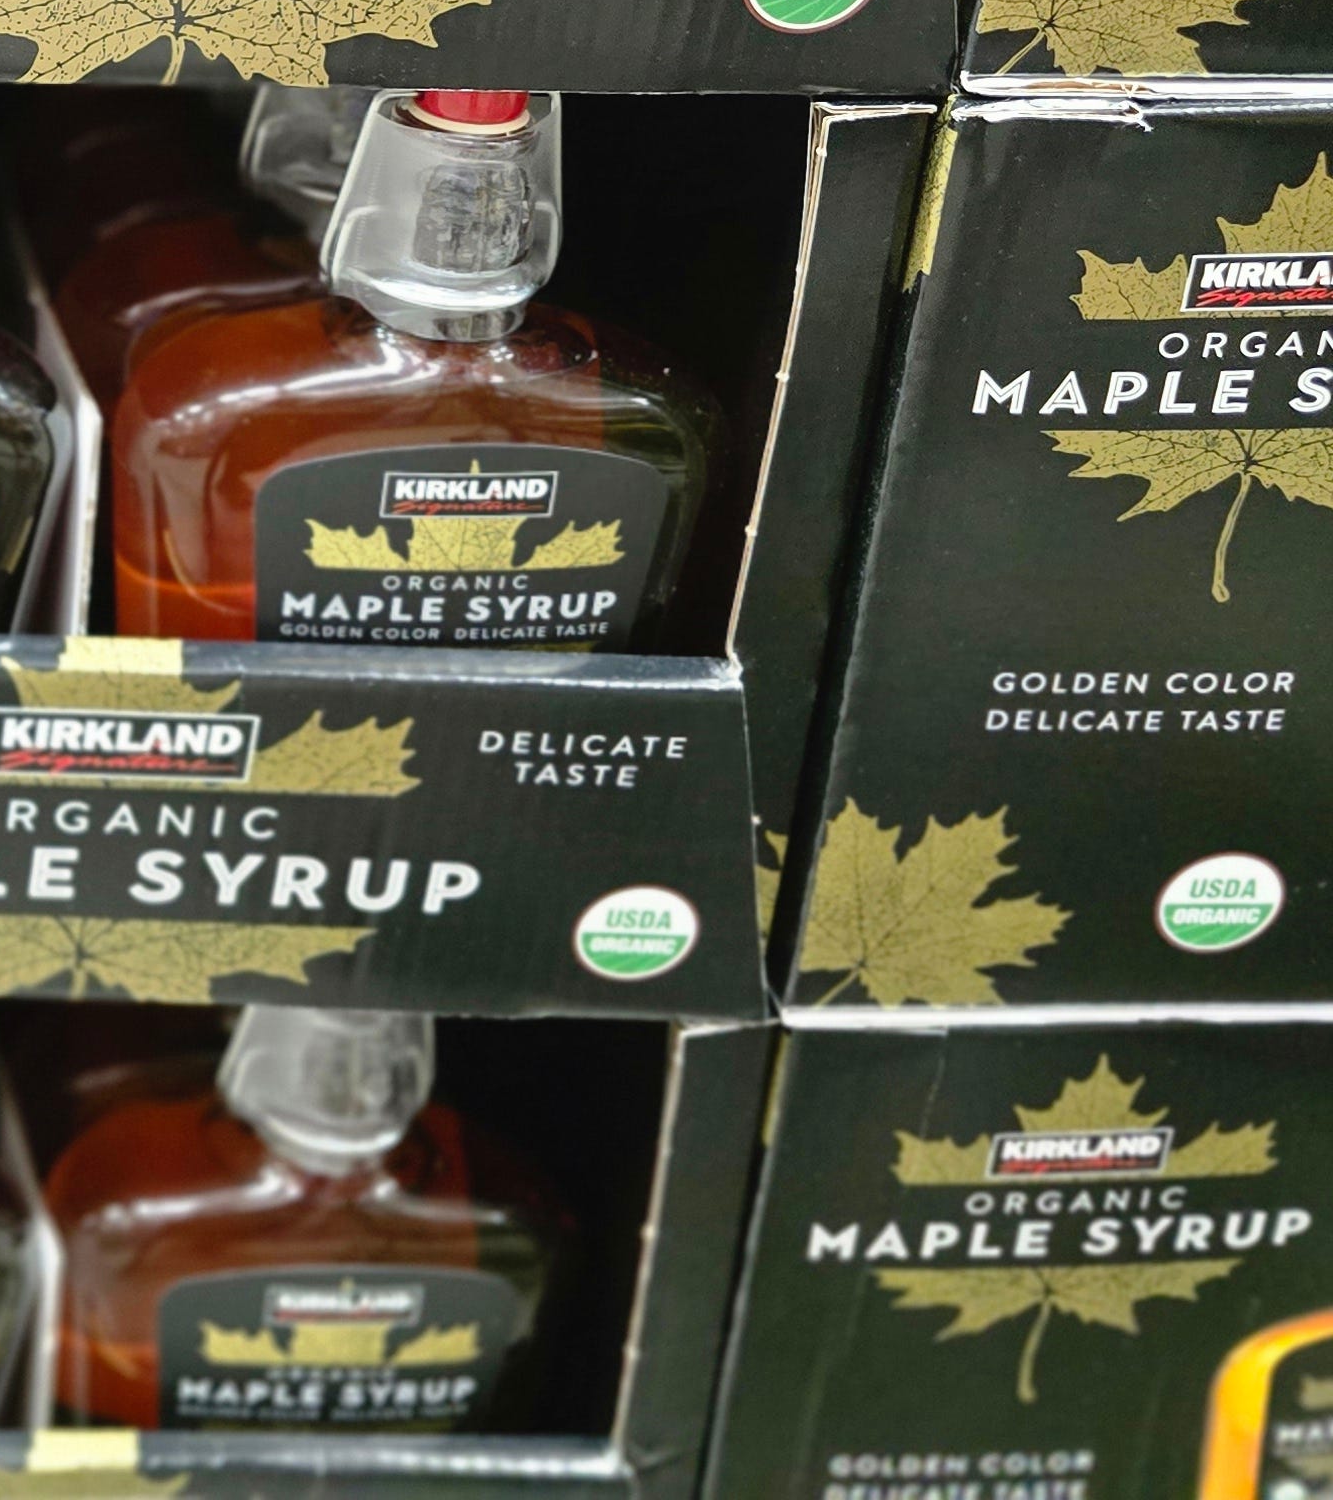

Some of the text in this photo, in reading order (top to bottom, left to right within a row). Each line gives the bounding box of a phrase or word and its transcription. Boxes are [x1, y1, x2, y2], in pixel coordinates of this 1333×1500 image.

[1201, 260, 1333, 288] KIRKLA
[1196, 286, 1333, 308] Signatu
[1159, 331, 1333, 359] ORGAN
[972, 369, 1254, 415] MAPLE
[394, 479, 548, 500] KIRKLAND
[382, 575, 528, 591] ORGANIC
[281, 591, 616, 622] MAPLE SYRUP
[280, 621, 608, 640] GOLDEN COLOR DELICATE TASTE
[993, 673, 1295, 694] GOLDEN COLOR
[986, 710, 1286, 732] DELICATE TASTE
[0, 717, 242, 754] KIRKLAND
[479, 731, 687, 759] DELICATE
[514, 763, 639, 788] TASTE
[131, 850, 478, 914] SYRUP
[1190, 878, 1257, 901] USDA
[605, 910, 671, 930] USDA
[1172, 907, 1260, 926] ORGANIC
[1001, 1136, 1161, 1162] KIRKLAND
[965, 1186, 1187, 1215] ORGANIC
[808, 1210, 1311, 1261] MAPLE SYRUP
